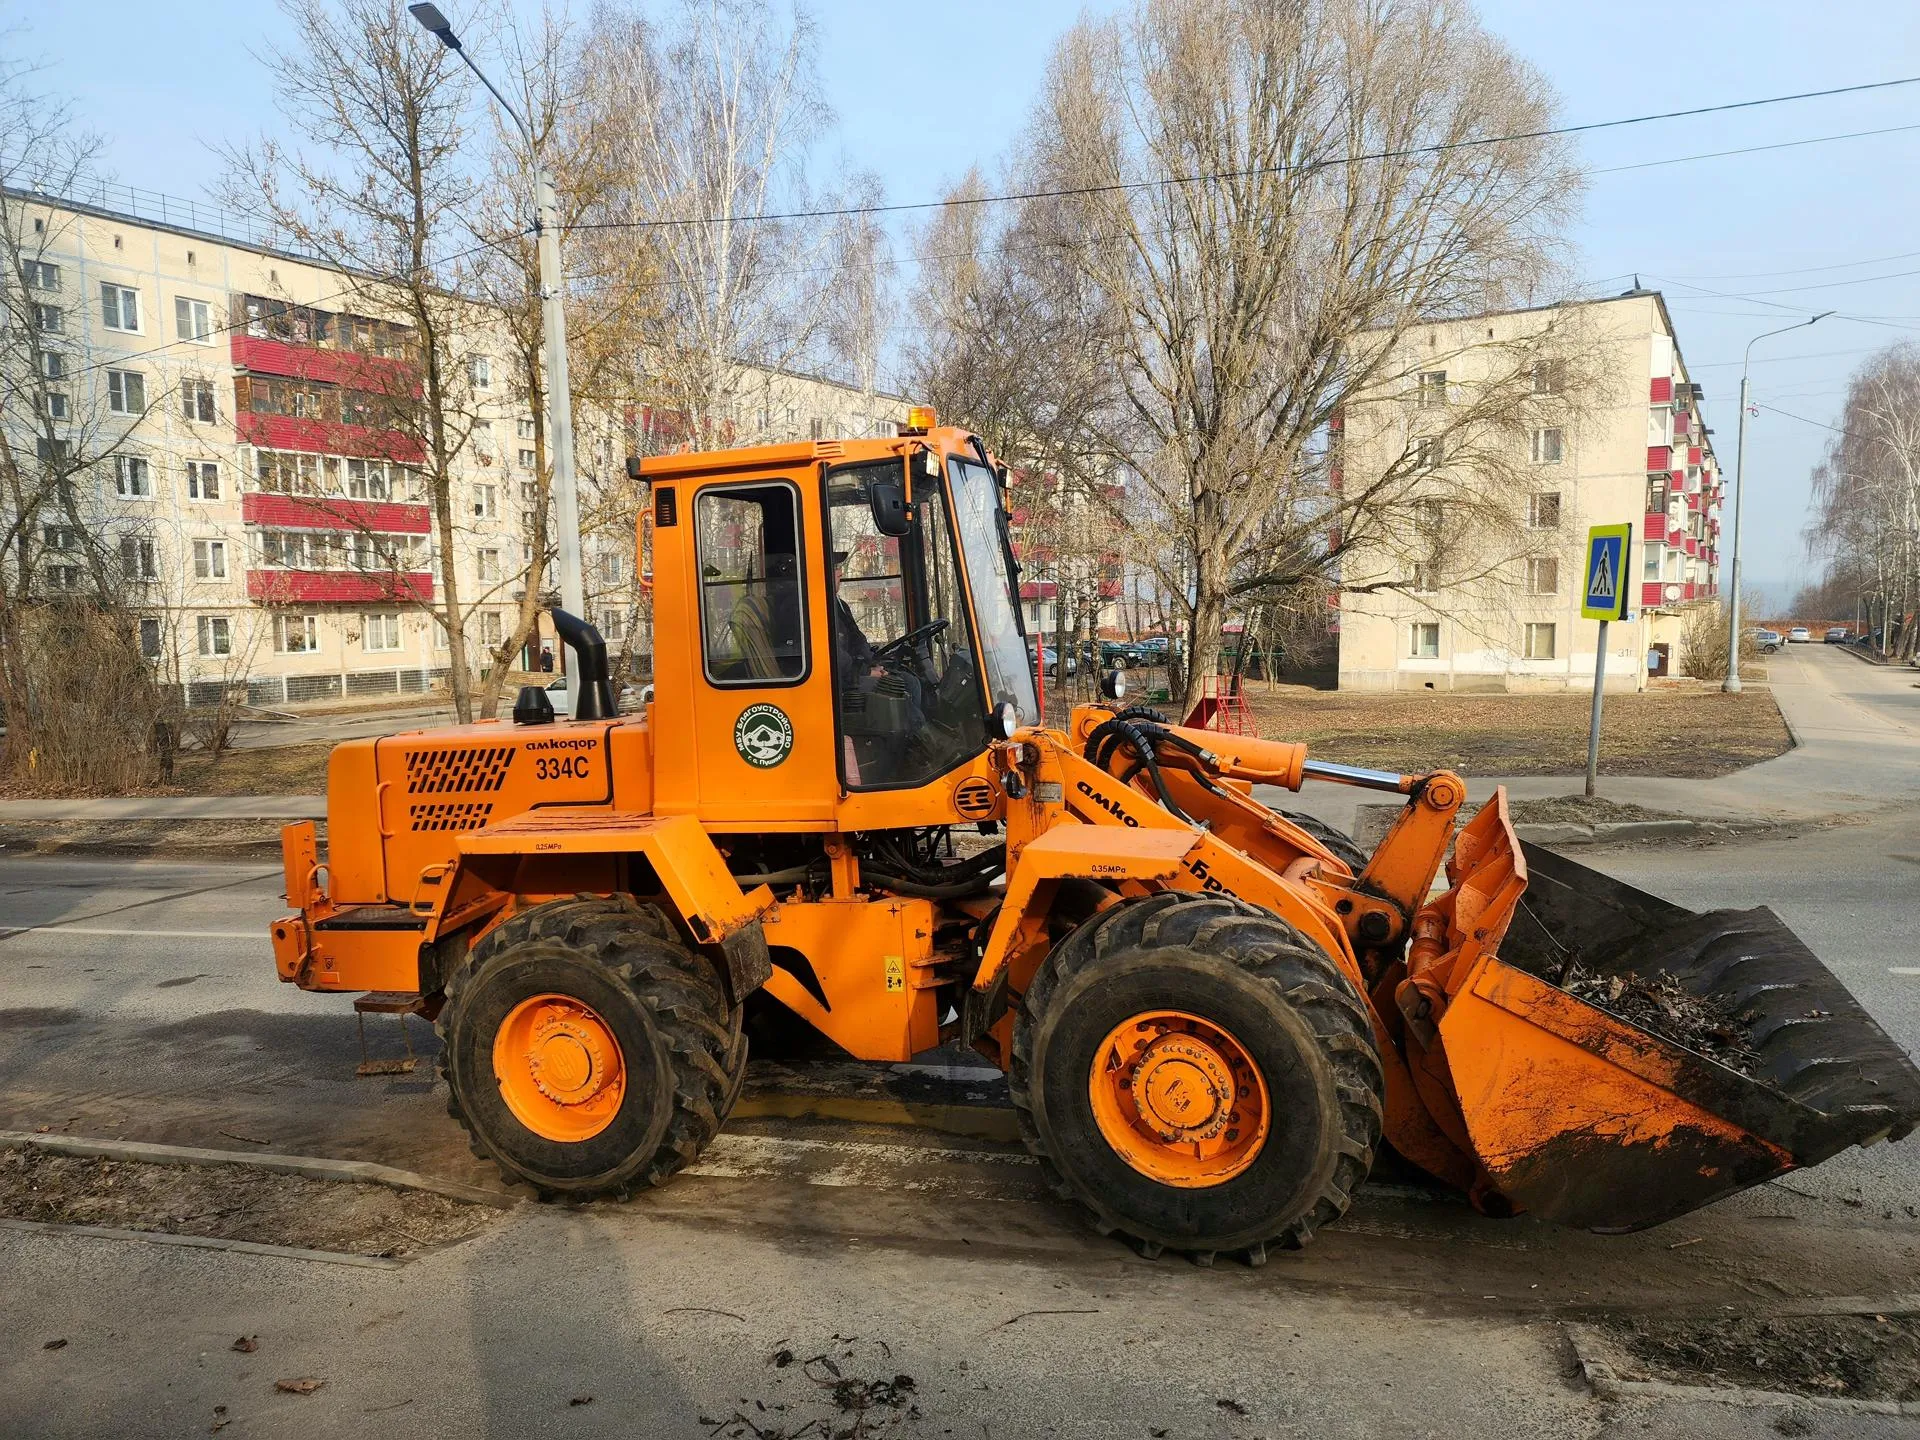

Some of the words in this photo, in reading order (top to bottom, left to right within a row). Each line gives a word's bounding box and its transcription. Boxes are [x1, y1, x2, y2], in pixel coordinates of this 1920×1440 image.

[735, 731, 745, 751] МБУ
[736, 704, 792, 749] БЛАГОУСТРОЙСТВО
[1076, 781, 1139, 828] амко
